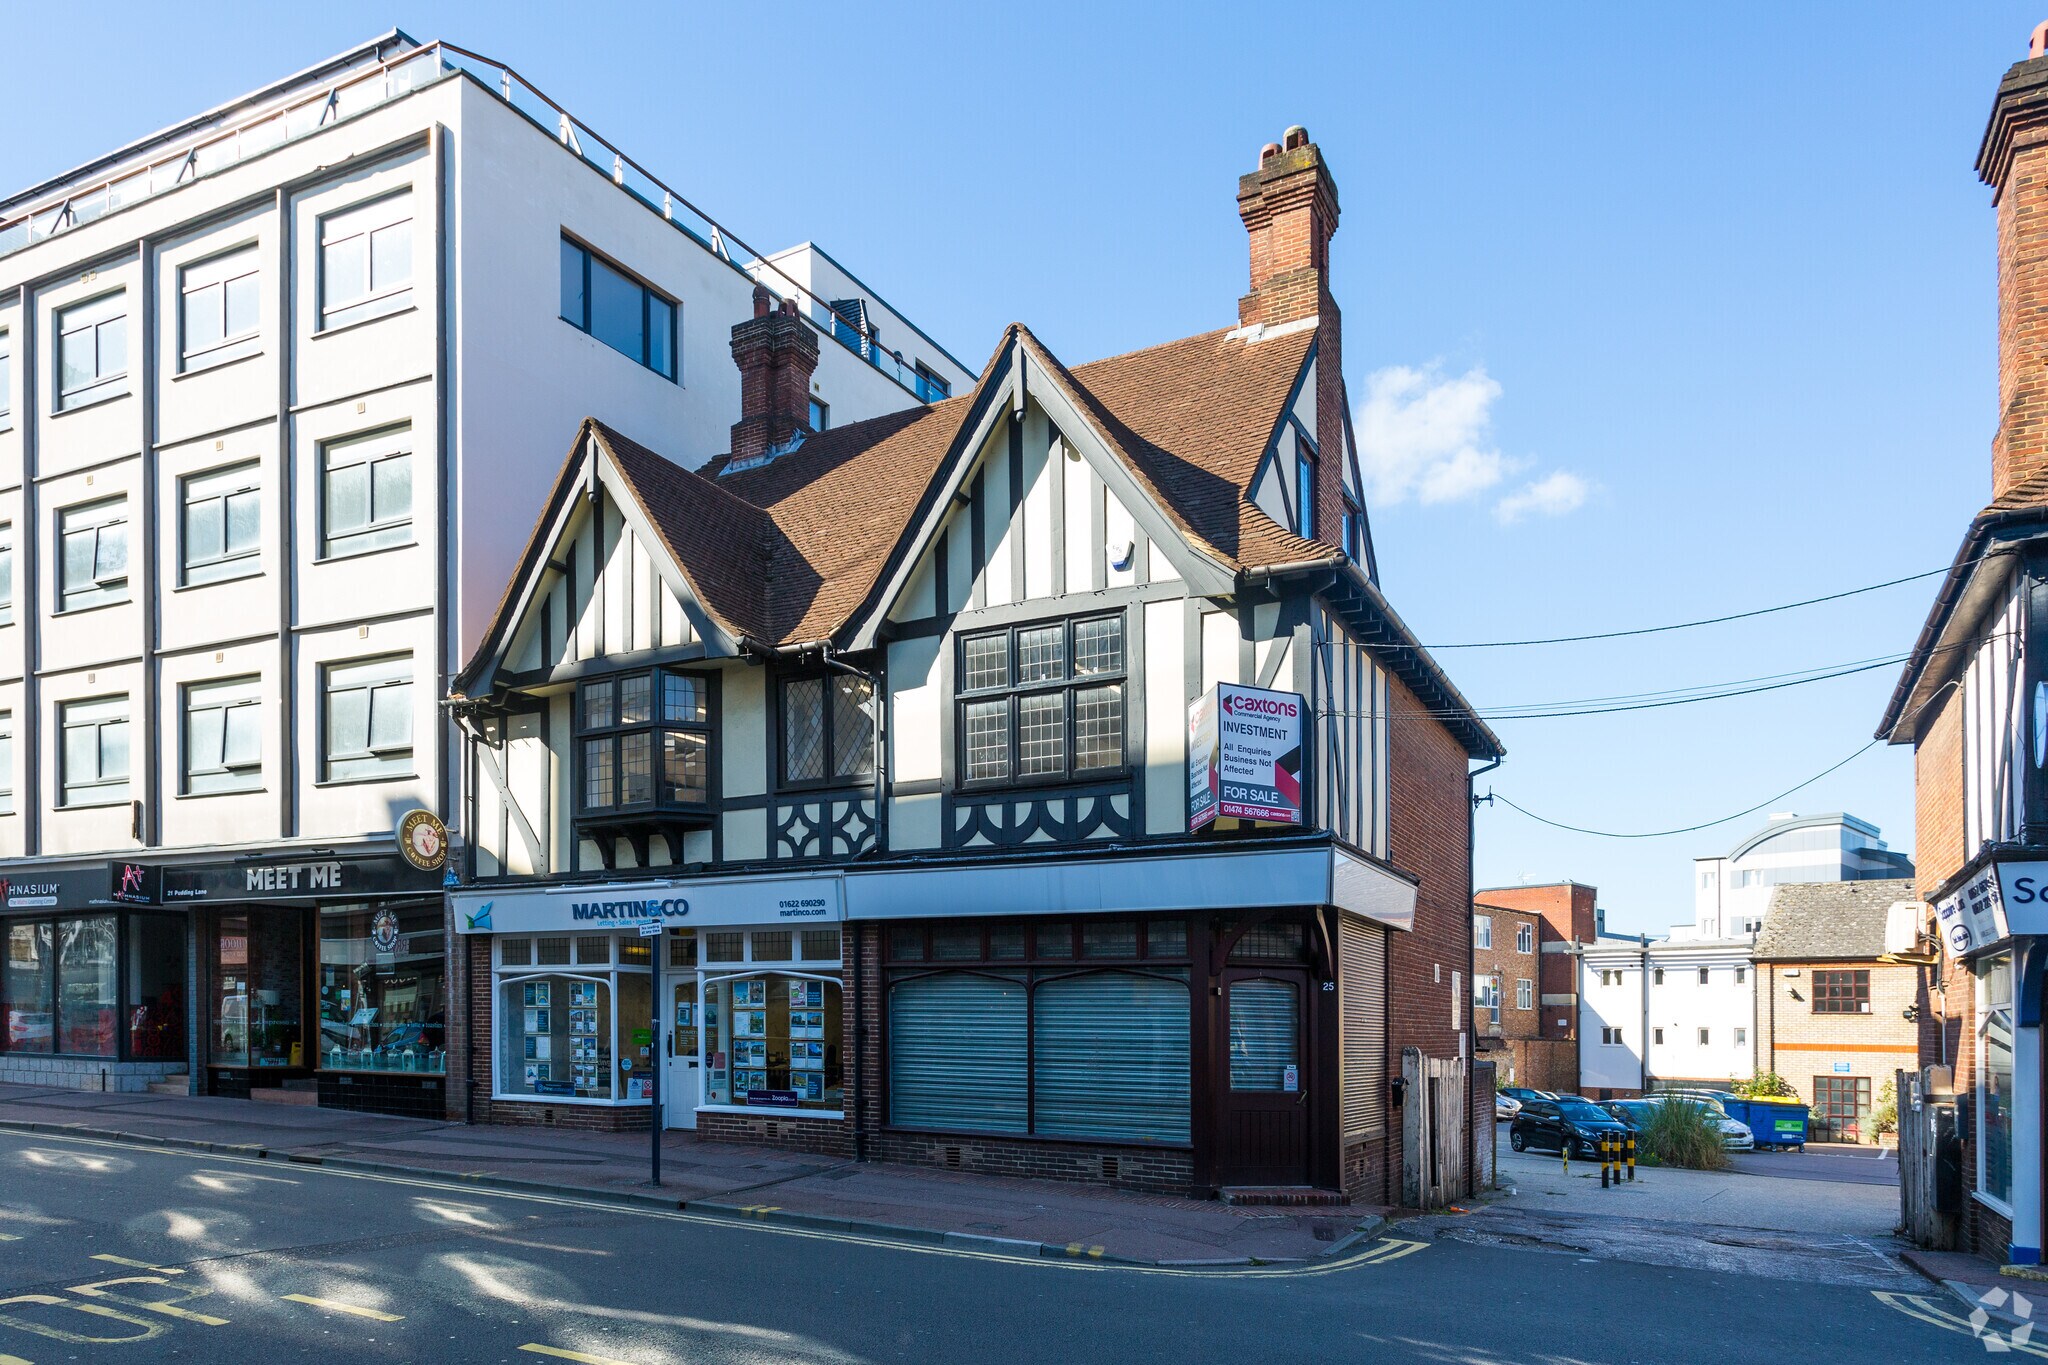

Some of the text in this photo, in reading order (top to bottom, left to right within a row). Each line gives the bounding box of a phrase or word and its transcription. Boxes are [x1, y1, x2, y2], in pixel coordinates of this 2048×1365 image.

[1234, 696, 1297, 717] caxtons
[1234, 710, 1281, 723] Commercial Agency
[1224, 721, 1287, 740] INVESTMENT
[1238, 745, 1271, 756] Enquiries
[1224, 754, 1272, 767] Business Not
[1224, 765, 1254, 775] Affected
[1191, 791, 1211, 813] FOR SALE
[1224, 786, 1279, 804] FOR SALE
[1223, 804, 1242, 814] 01474
[1244, 807, 1270, 818] 567666
[406, 814, 443, 835] MEET ME
[407, 847, 446, 867] COFFEE SHOP
[246, 863, 342, 891] MEET ME
[174, 889, 194, 897] Pudding
[571, 899, 689, 920] MARTIN&CO
[779, 899, 826, 908] 01622 690290
[373, 909, 387, 925] MEET
[780, 908, 827, 917] martinco.com
[596, 919, 616, 928] Letting
[1322, 982, 1335, 991] 25
